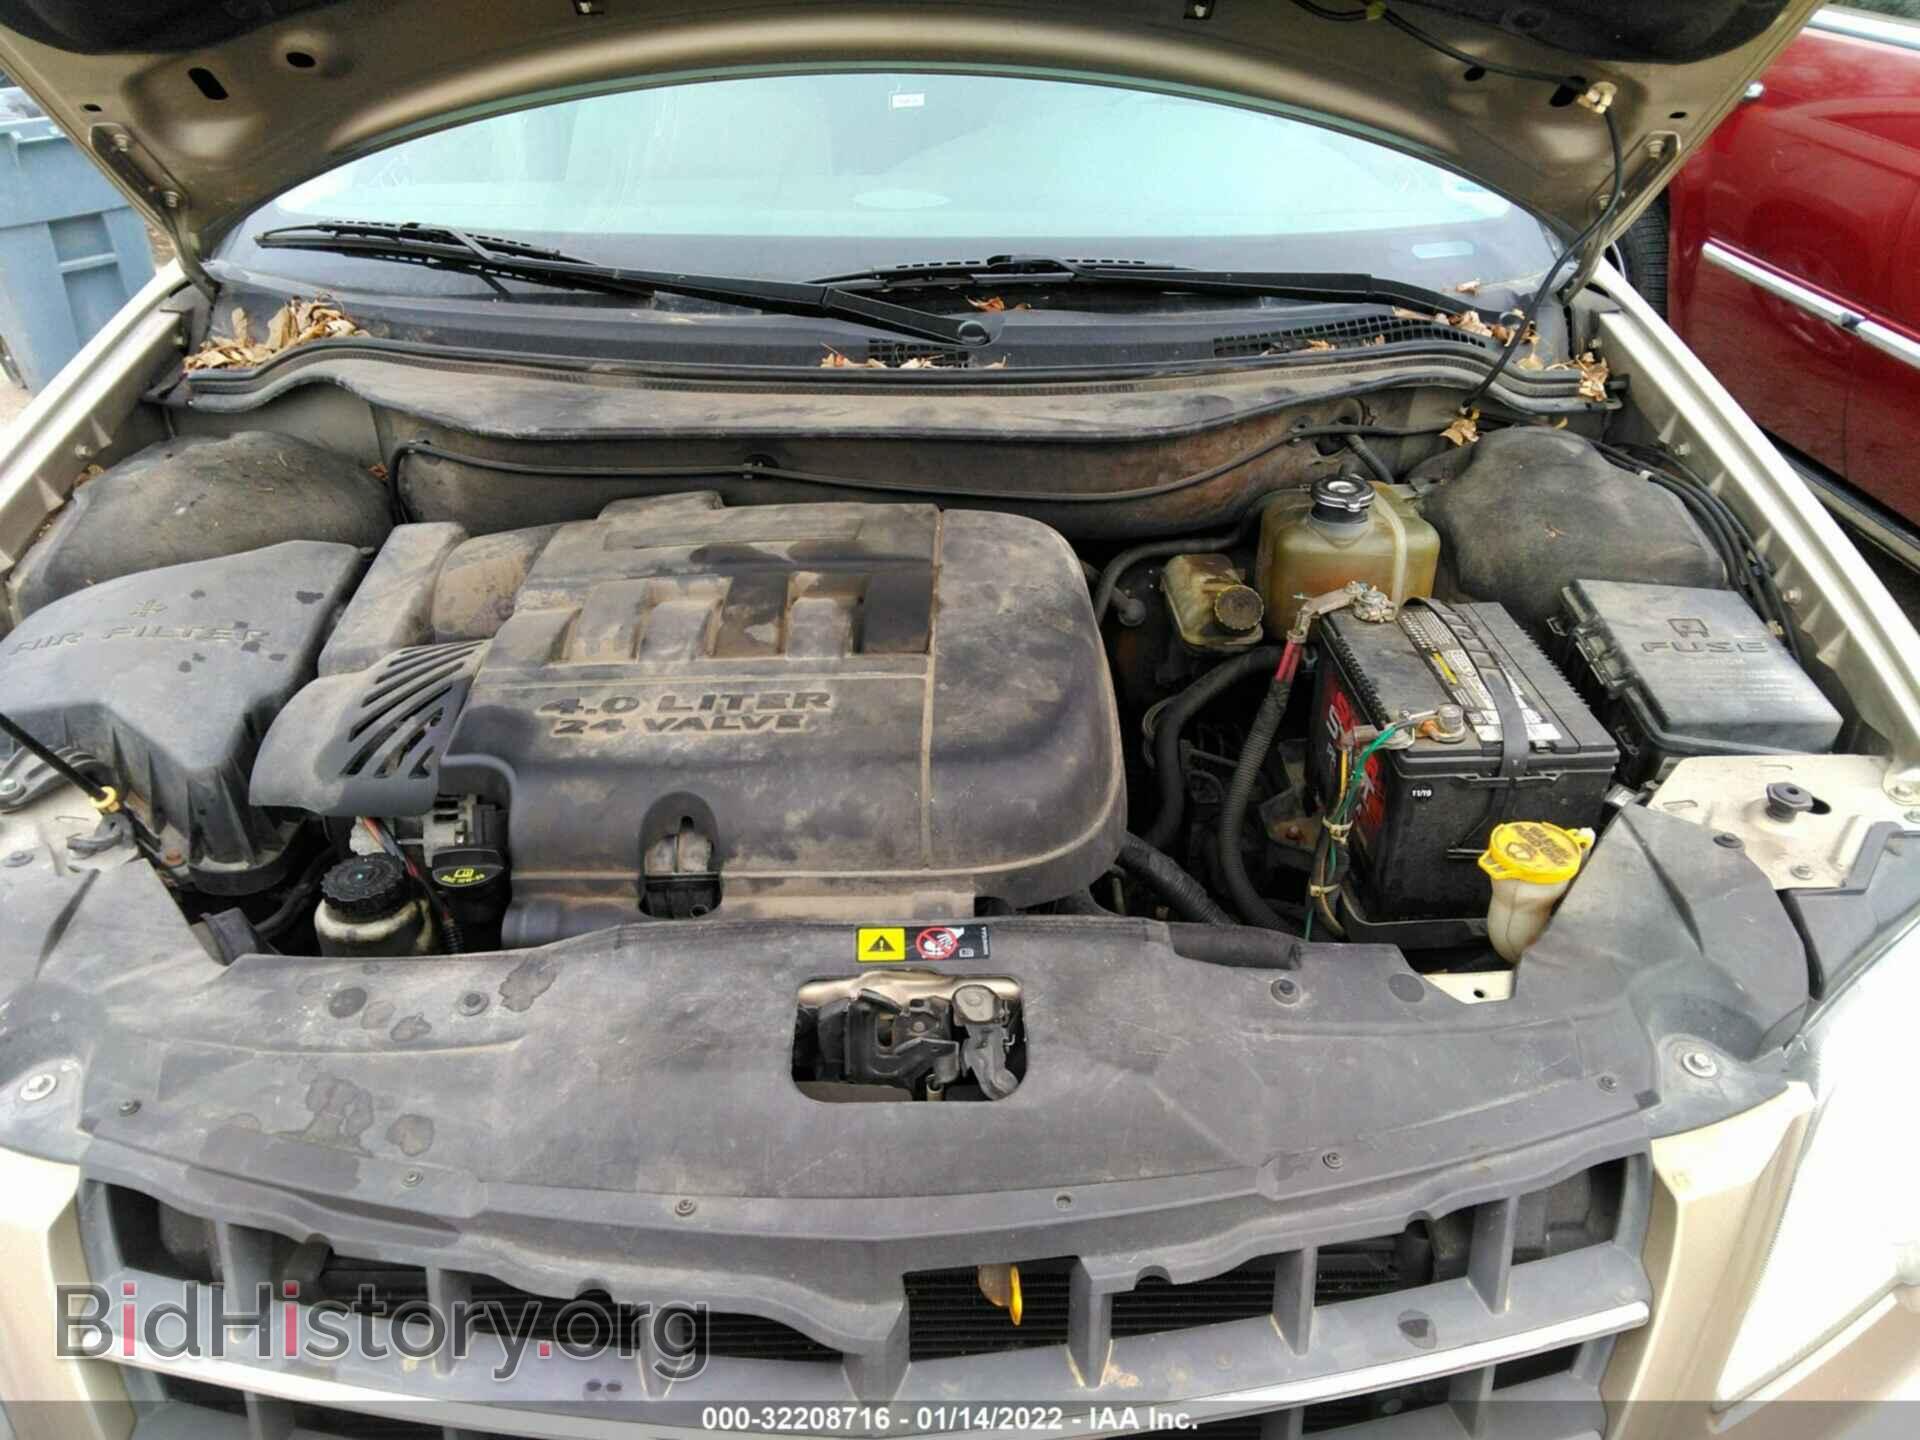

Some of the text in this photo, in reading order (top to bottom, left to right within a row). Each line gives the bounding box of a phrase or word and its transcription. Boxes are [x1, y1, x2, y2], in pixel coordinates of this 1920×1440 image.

[9, 624, 271, 656] AIR FILTER
[1641, 641, 1769, 653] FUSE
[538, 692, 832, 714] 4.0 LITER
[554, 715, 804, 734] 24 VALVE
